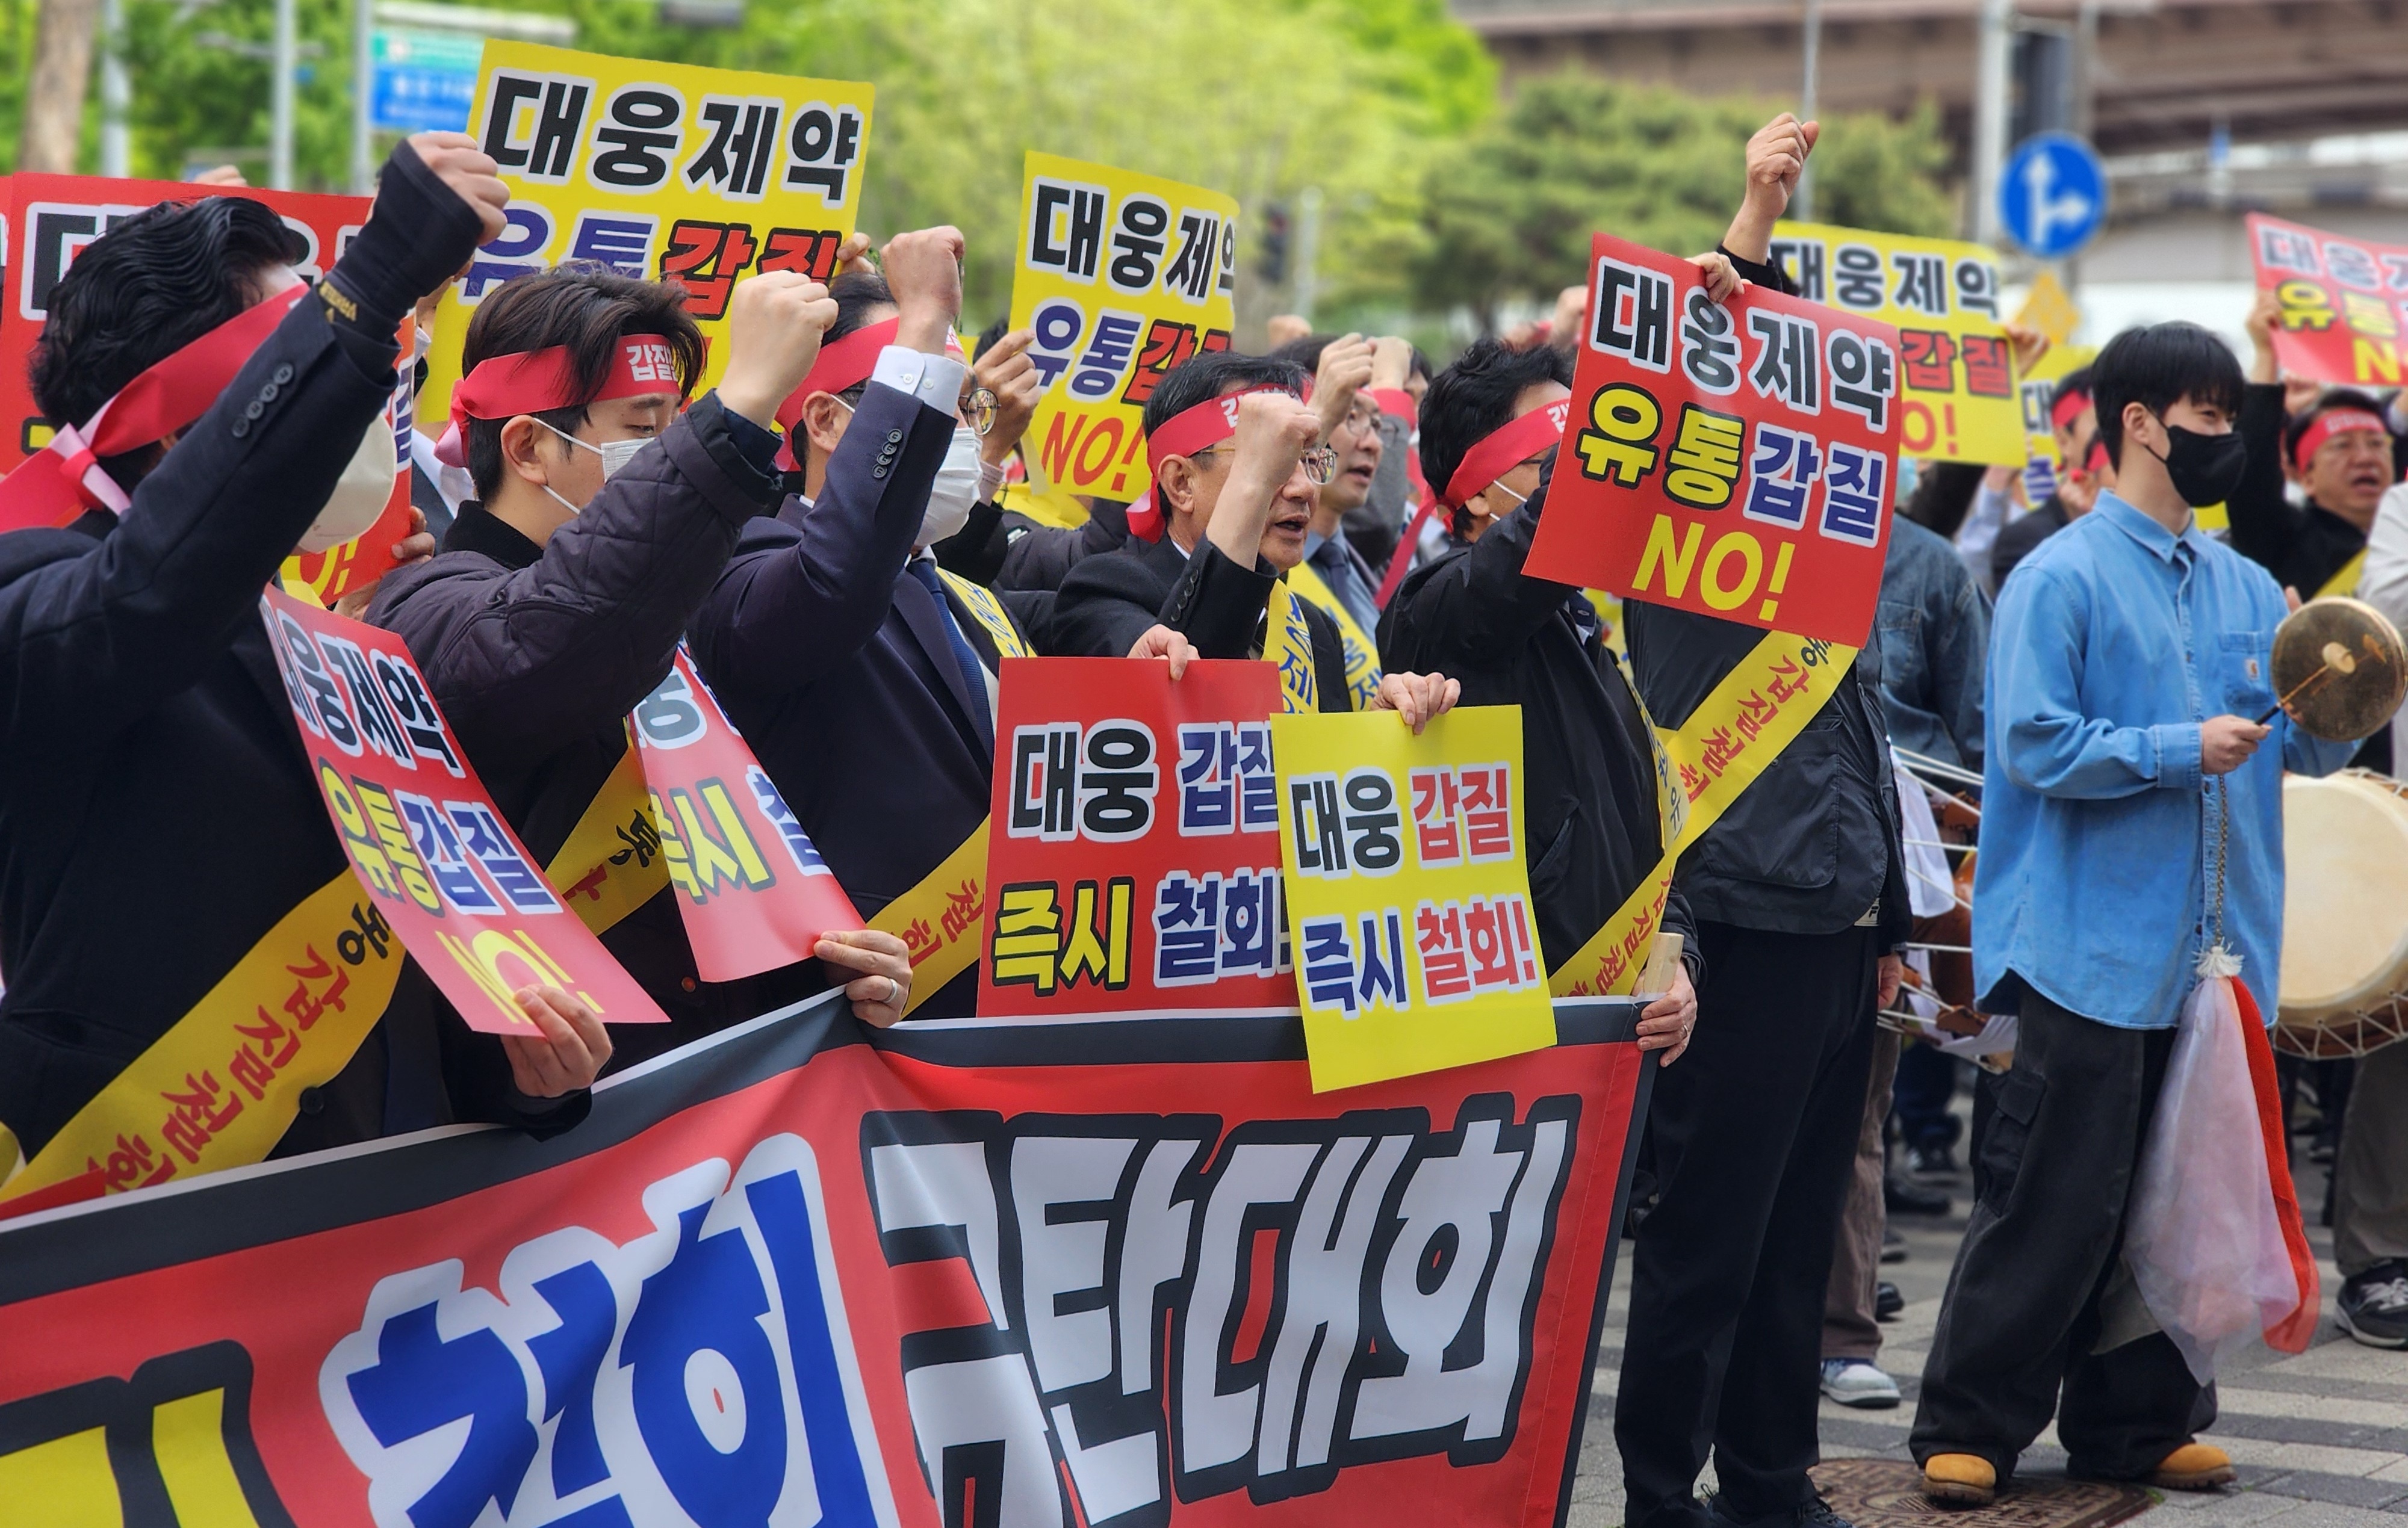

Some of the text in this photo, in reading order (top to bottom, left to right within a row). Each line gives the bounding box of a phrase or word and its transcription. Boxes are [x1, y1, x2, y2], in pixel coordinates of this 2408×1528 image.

[485, 75, 859, 200] 대웅제약
[1770, 243, 1999, 321] 대웅제약
[1027, 305, 1232, 402] 유통 갑
[1597, 265, 1892, 427] 대웅제약
[1901, 330, 2011, 396] 갑질
[1042, 411, 1144, 492] NO!
[1579, 387, 1882, 540] 유통 갑질
[1632, 515, 1795, 622] NO!
[1013, 728, 1278, 833] 대웅 갑질
[1291, 768, 1510, 871] 대웅 갑질
[321, 764, 559, 910] 유통 갑질
[995, 884, 1130, 989] 즉시
[1304, 901, 1536, 1012] 즉시 철회!
